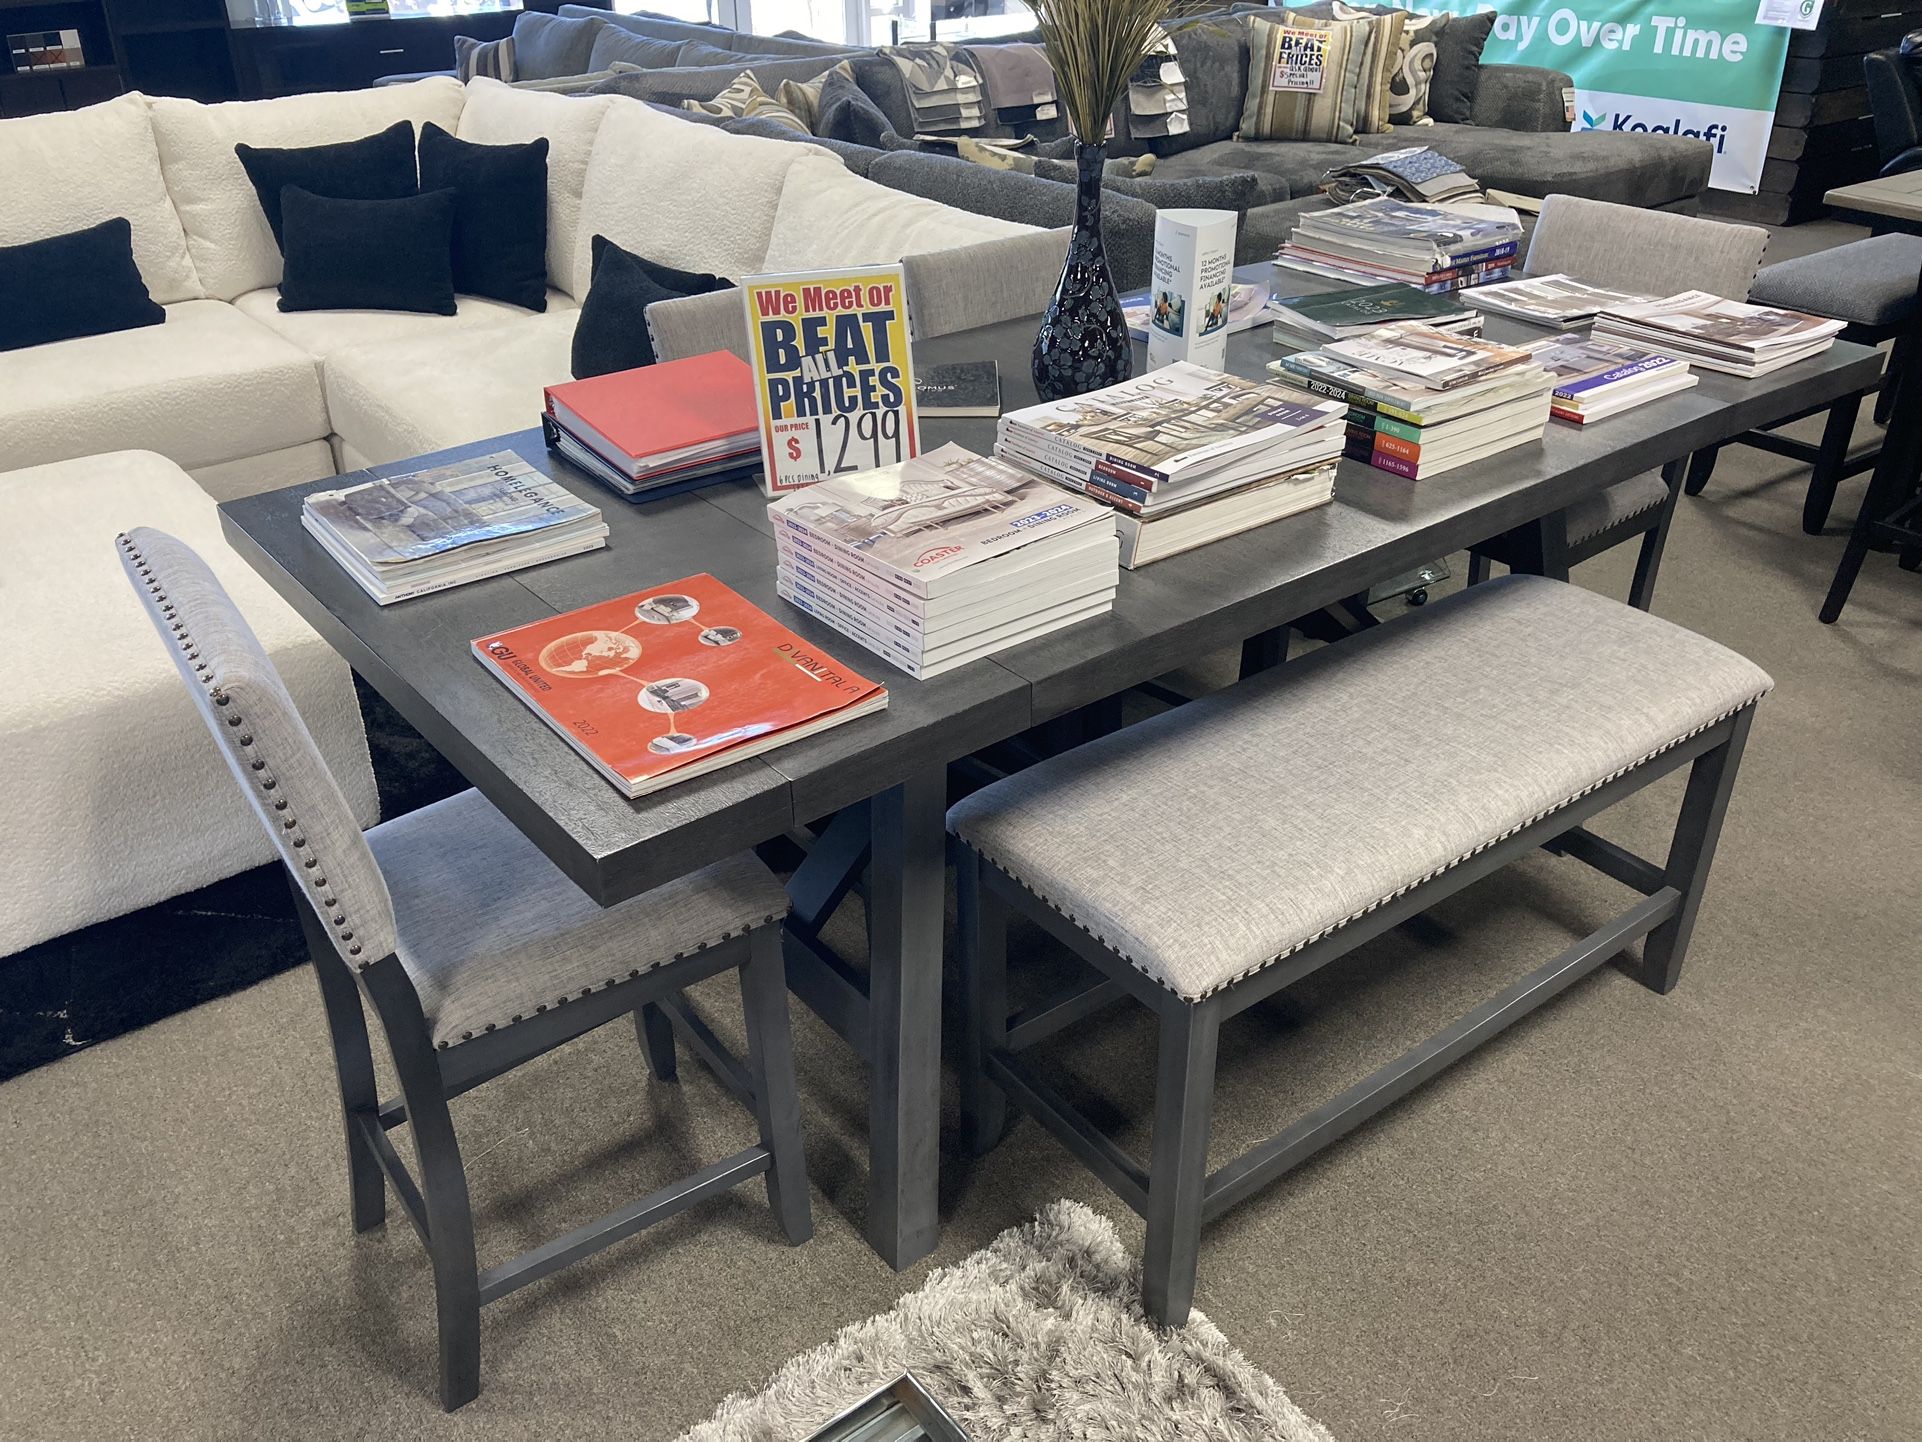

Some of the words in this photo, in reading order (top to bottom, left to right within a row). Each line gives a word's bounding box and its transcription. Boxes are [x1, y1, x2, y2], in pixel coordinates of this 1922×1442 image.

[1477, 3, 1540, 51] ay
[1547, 8, 1640, 51] Over
[1651, 15, 1749, 63] Time
[1280, 36, 1327, 52] BEAT
[1278, 51, 1323, 66] PRICES
[1208, 253, 1227, 265] MONTHS
[756, 289, 798, 317] We
[802, 284, 864, 313] Meet
[868, 284, 893, 308] or
[760, 309, 896, 375] BEAT
[800, 350, 844, 384] ALL
[768, 365, 904, 421] PRICES
[1310, 381, 1347, 399] 2022-2024
[1554, 390, 1572, 399] 2022
[774, 423, 789, 434] OUR
[789, 422, 810, 431] PRICE
[787, 436, 802, 462] $
[814, 409, 902, 476] 1,299
[1047, 444, 1073, 458] CATALOG
[1054, 436, 1082, 450] CATALOG
[1044, 454, 1069, 469] CATALOG
[1040, 465, 1065, 480] CATALOG
[1013, 504, 1070, 528] 2023-2024
[980, 529, 1021, 545] BEDROOM
[809, 531, 831, 546] BEDROOM
[850, 552, 865, 564] ROOM
[913, 545, 964, 568] COASTER
[813, 549, 834, 564] BEDROOM
[851, 569, 866, 581] ROOM
[816, 579, 837, 593] BEDROOM
[853, 601, 867, 612] ROOM
[816, 593, 836, 609] BEDROOM
[852, 616, 867, 628] ROOM
[529, 673, 552, 692] UNITED
[573, 720, 599, 736] 2022
